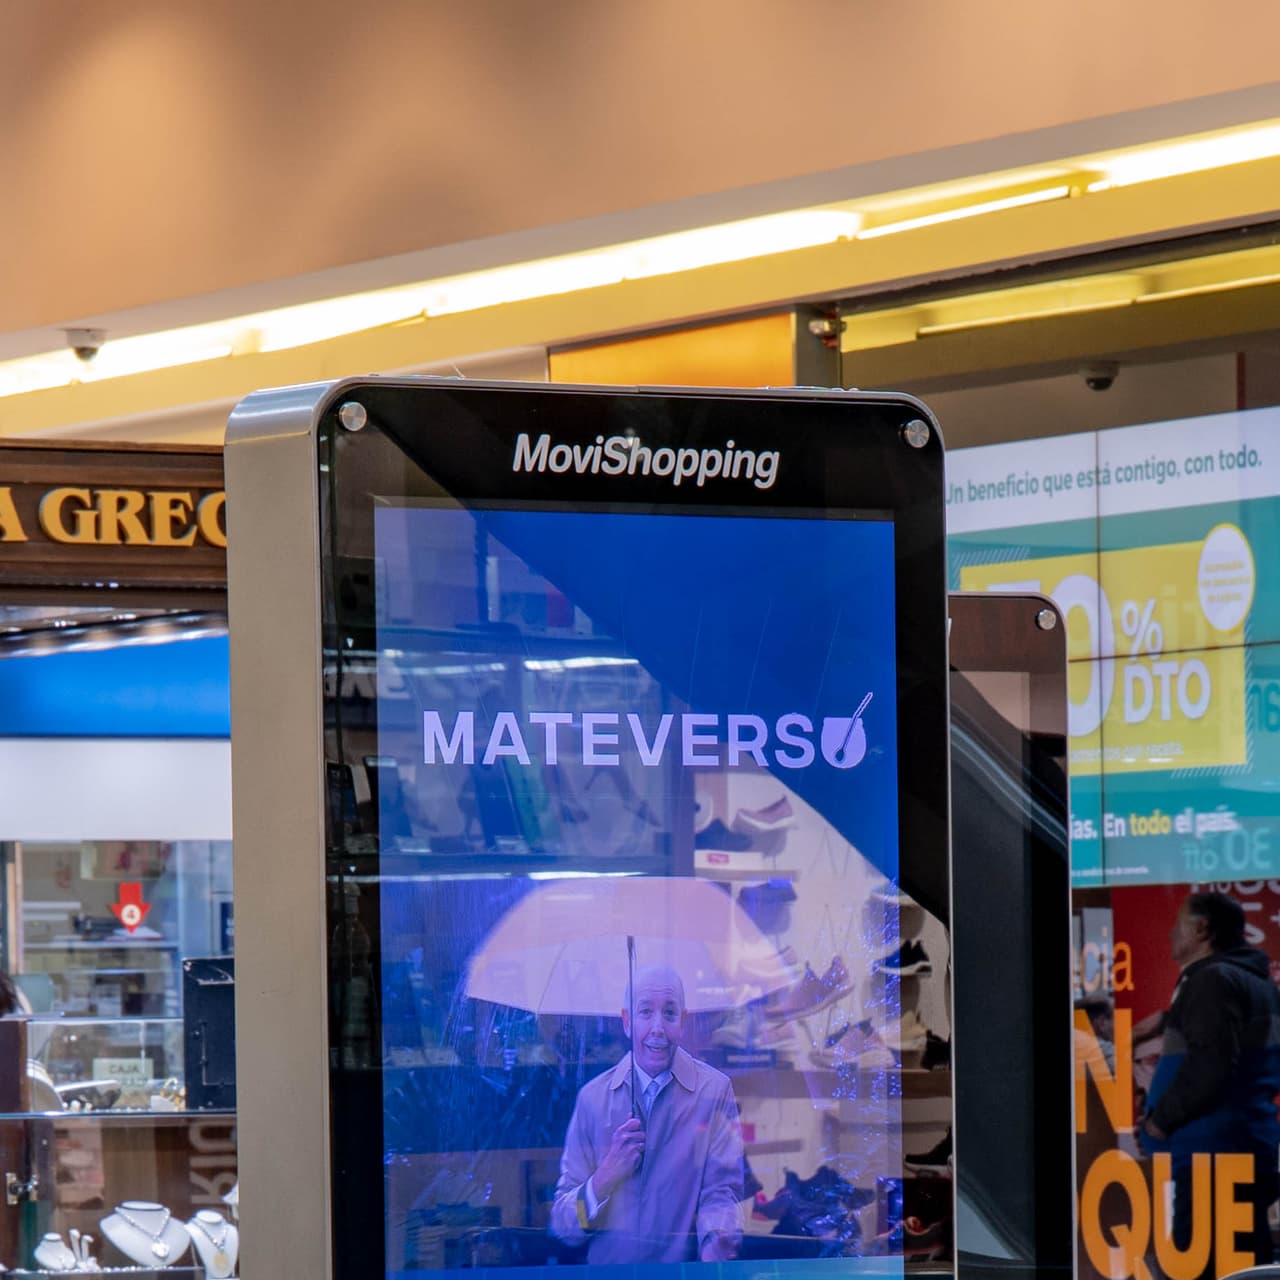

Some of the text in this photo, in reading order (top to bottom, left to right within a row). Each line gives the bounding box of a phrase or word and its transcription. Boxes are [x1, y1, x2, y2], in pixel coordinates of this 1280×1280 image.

[512, 433, 780, 488] MoviShopping
[967, 472, 1039, 502] beneficio
[1043, 473, 1072, 498] que
[1076, 462, 1111, 487] está
[1115, 455, 1180, 485] contigo,
[1184, 456, 1214, 476] con
[1219, 445, 1262, 471] todo.
[1123, 658, 1212, 724] DTO
[1103, 813, 1126, 838] En
[1129, 809, 1171, 836] todo
[1175, 807, 1194, 834] el
